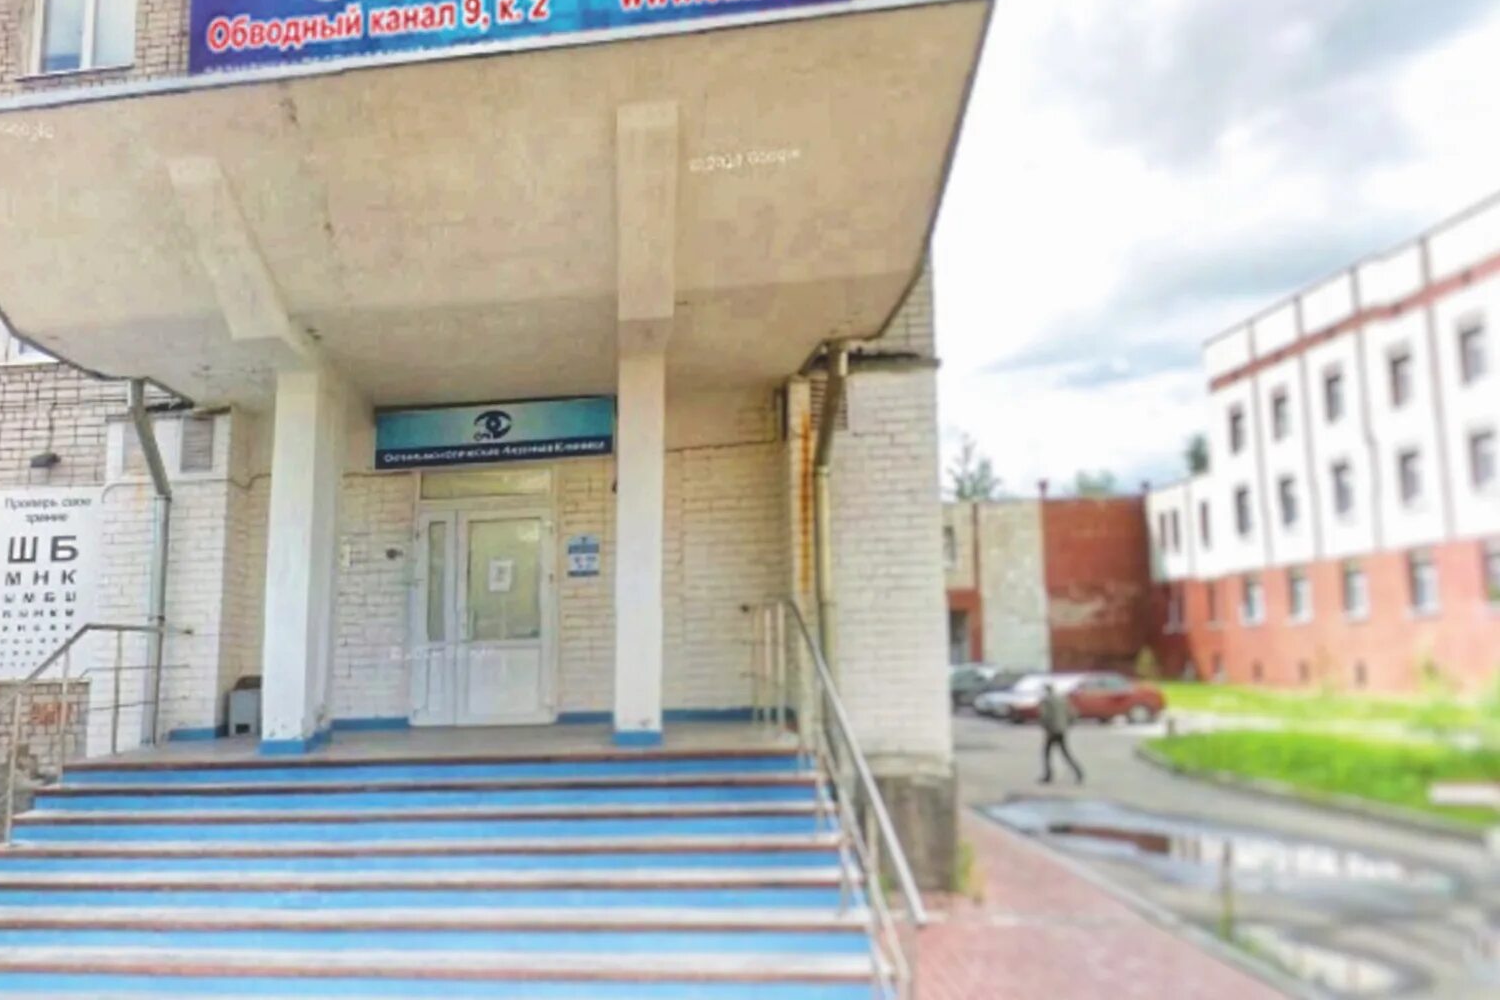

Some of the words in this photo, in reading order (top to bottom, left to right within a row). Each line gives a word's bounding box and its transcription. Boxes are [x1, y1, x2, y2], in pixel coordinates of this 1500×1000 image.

[206, 4, 362, 51] Обводный
[368, 2, 456, 35] канал
[7, 535, 39, 564] Ш
[49, 535, 79, 562] Б
[4, 571, 22, 586] М
[32, 569, 50, 585] Н
[60, 568, 78, 585] К
